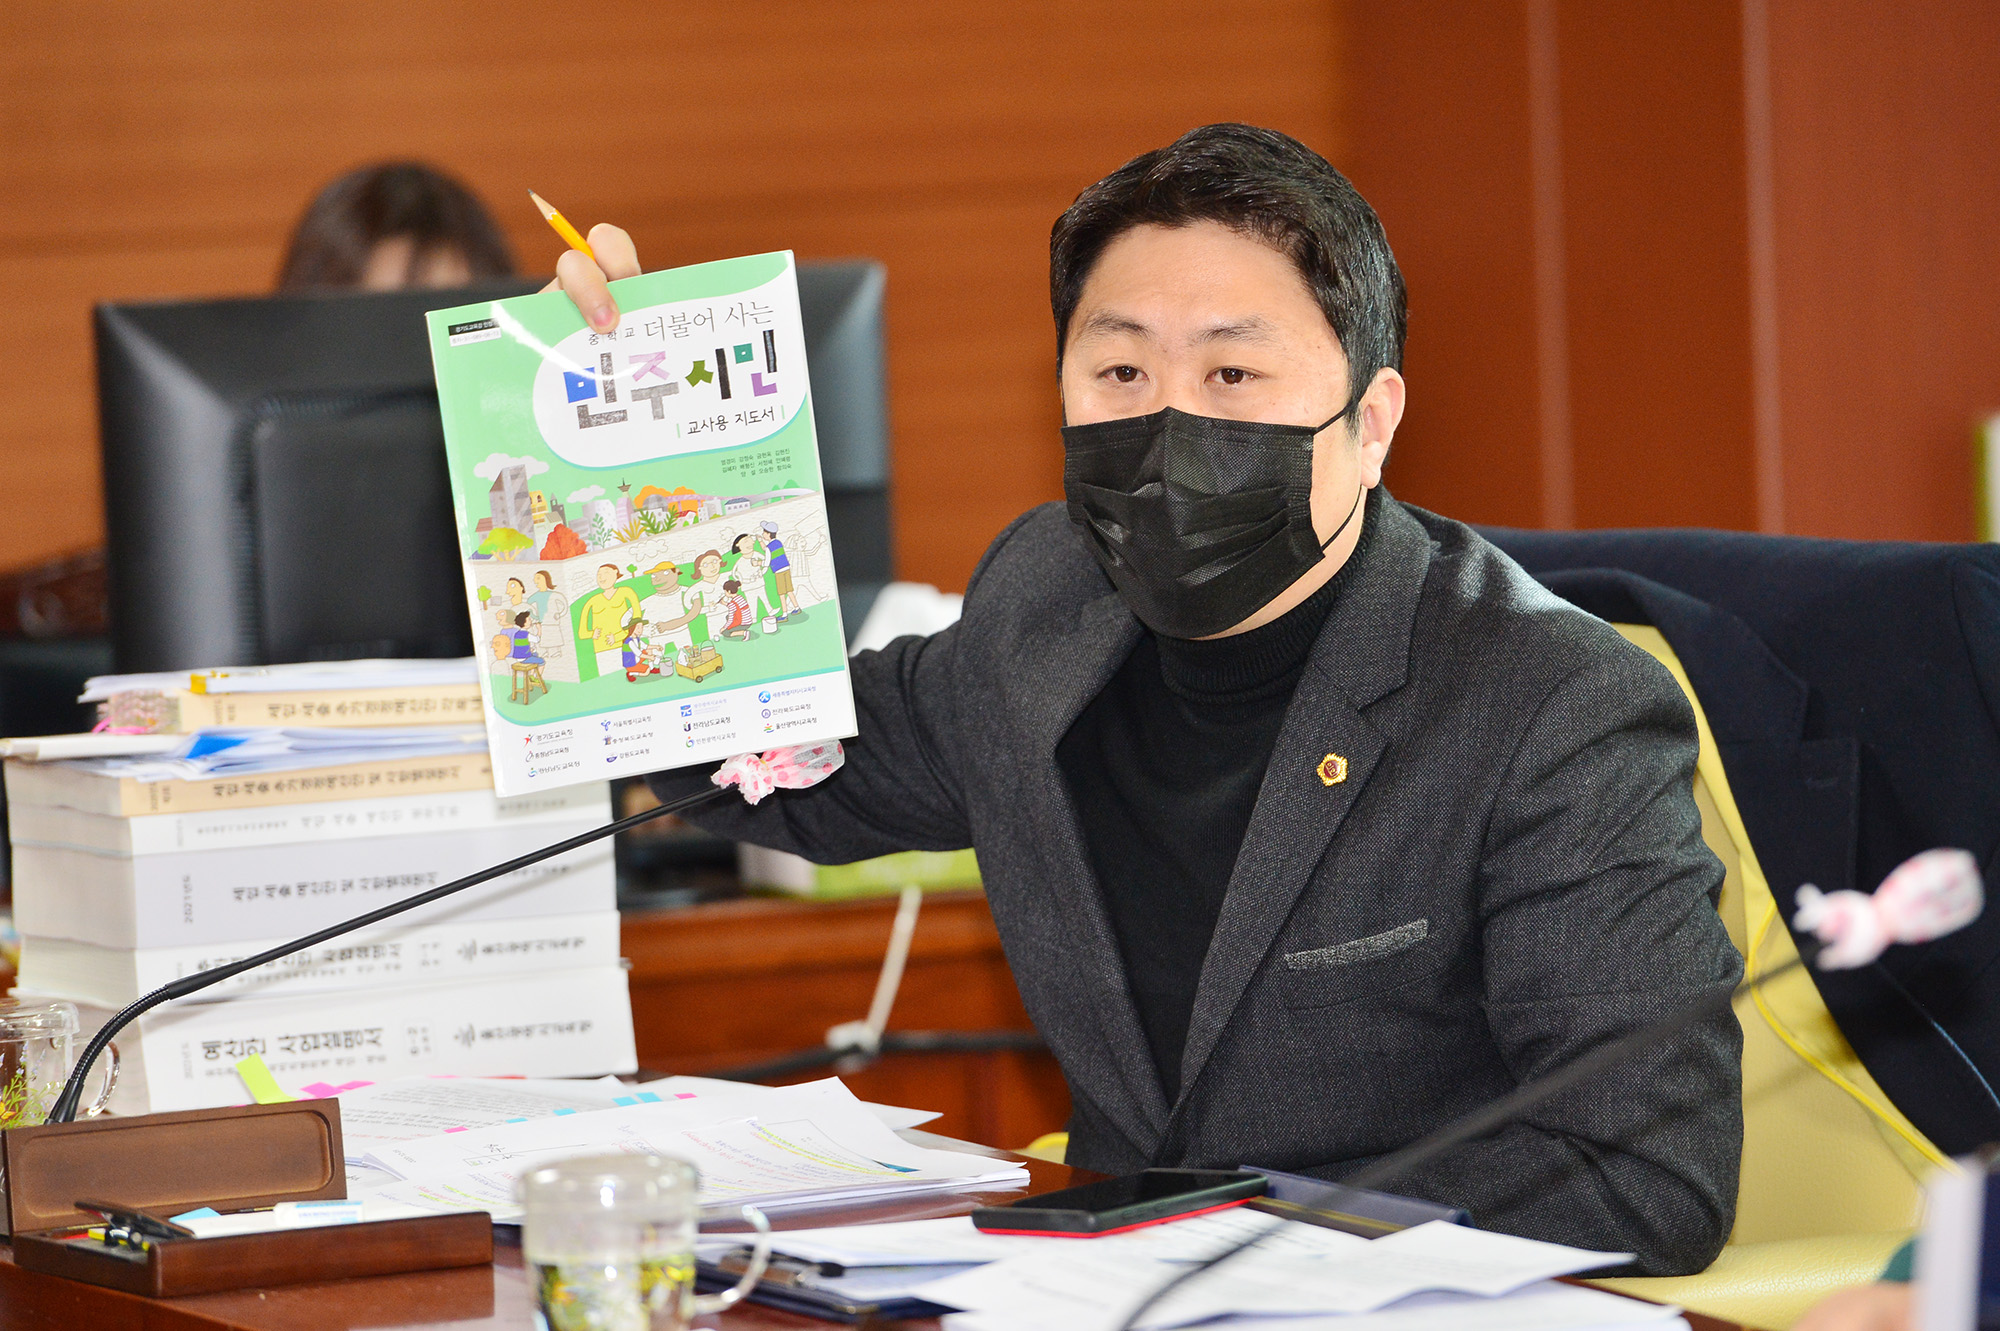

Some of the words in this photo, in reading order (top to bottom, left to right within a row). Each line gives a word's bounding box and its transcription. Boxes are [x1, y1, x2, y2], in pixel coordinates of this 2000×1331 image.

[643, 307, 715, 342] 더불어
[724, 301, 775, 328] 사는
[563, 329, 779, 430] 민주시민
[687, 414, 730, 435] 교사용
[734, 405, 776, 426] 지도서
[771, 703, 812, 716] 전라북도교육청
[613, 715, 652, 728] 서울특별시교육청
[692, 716, 731, 730] 전라남도교육청
[775, 717, 818, 730] 울산광역시교육청
[536, 728, 573, 742] 경기도교육청
[695, 731, 737, 745] 인천광역시교육청
[201, 1037, 268, 1061] 예산안
[277, 1027, 385, 1055] 사업설명서
